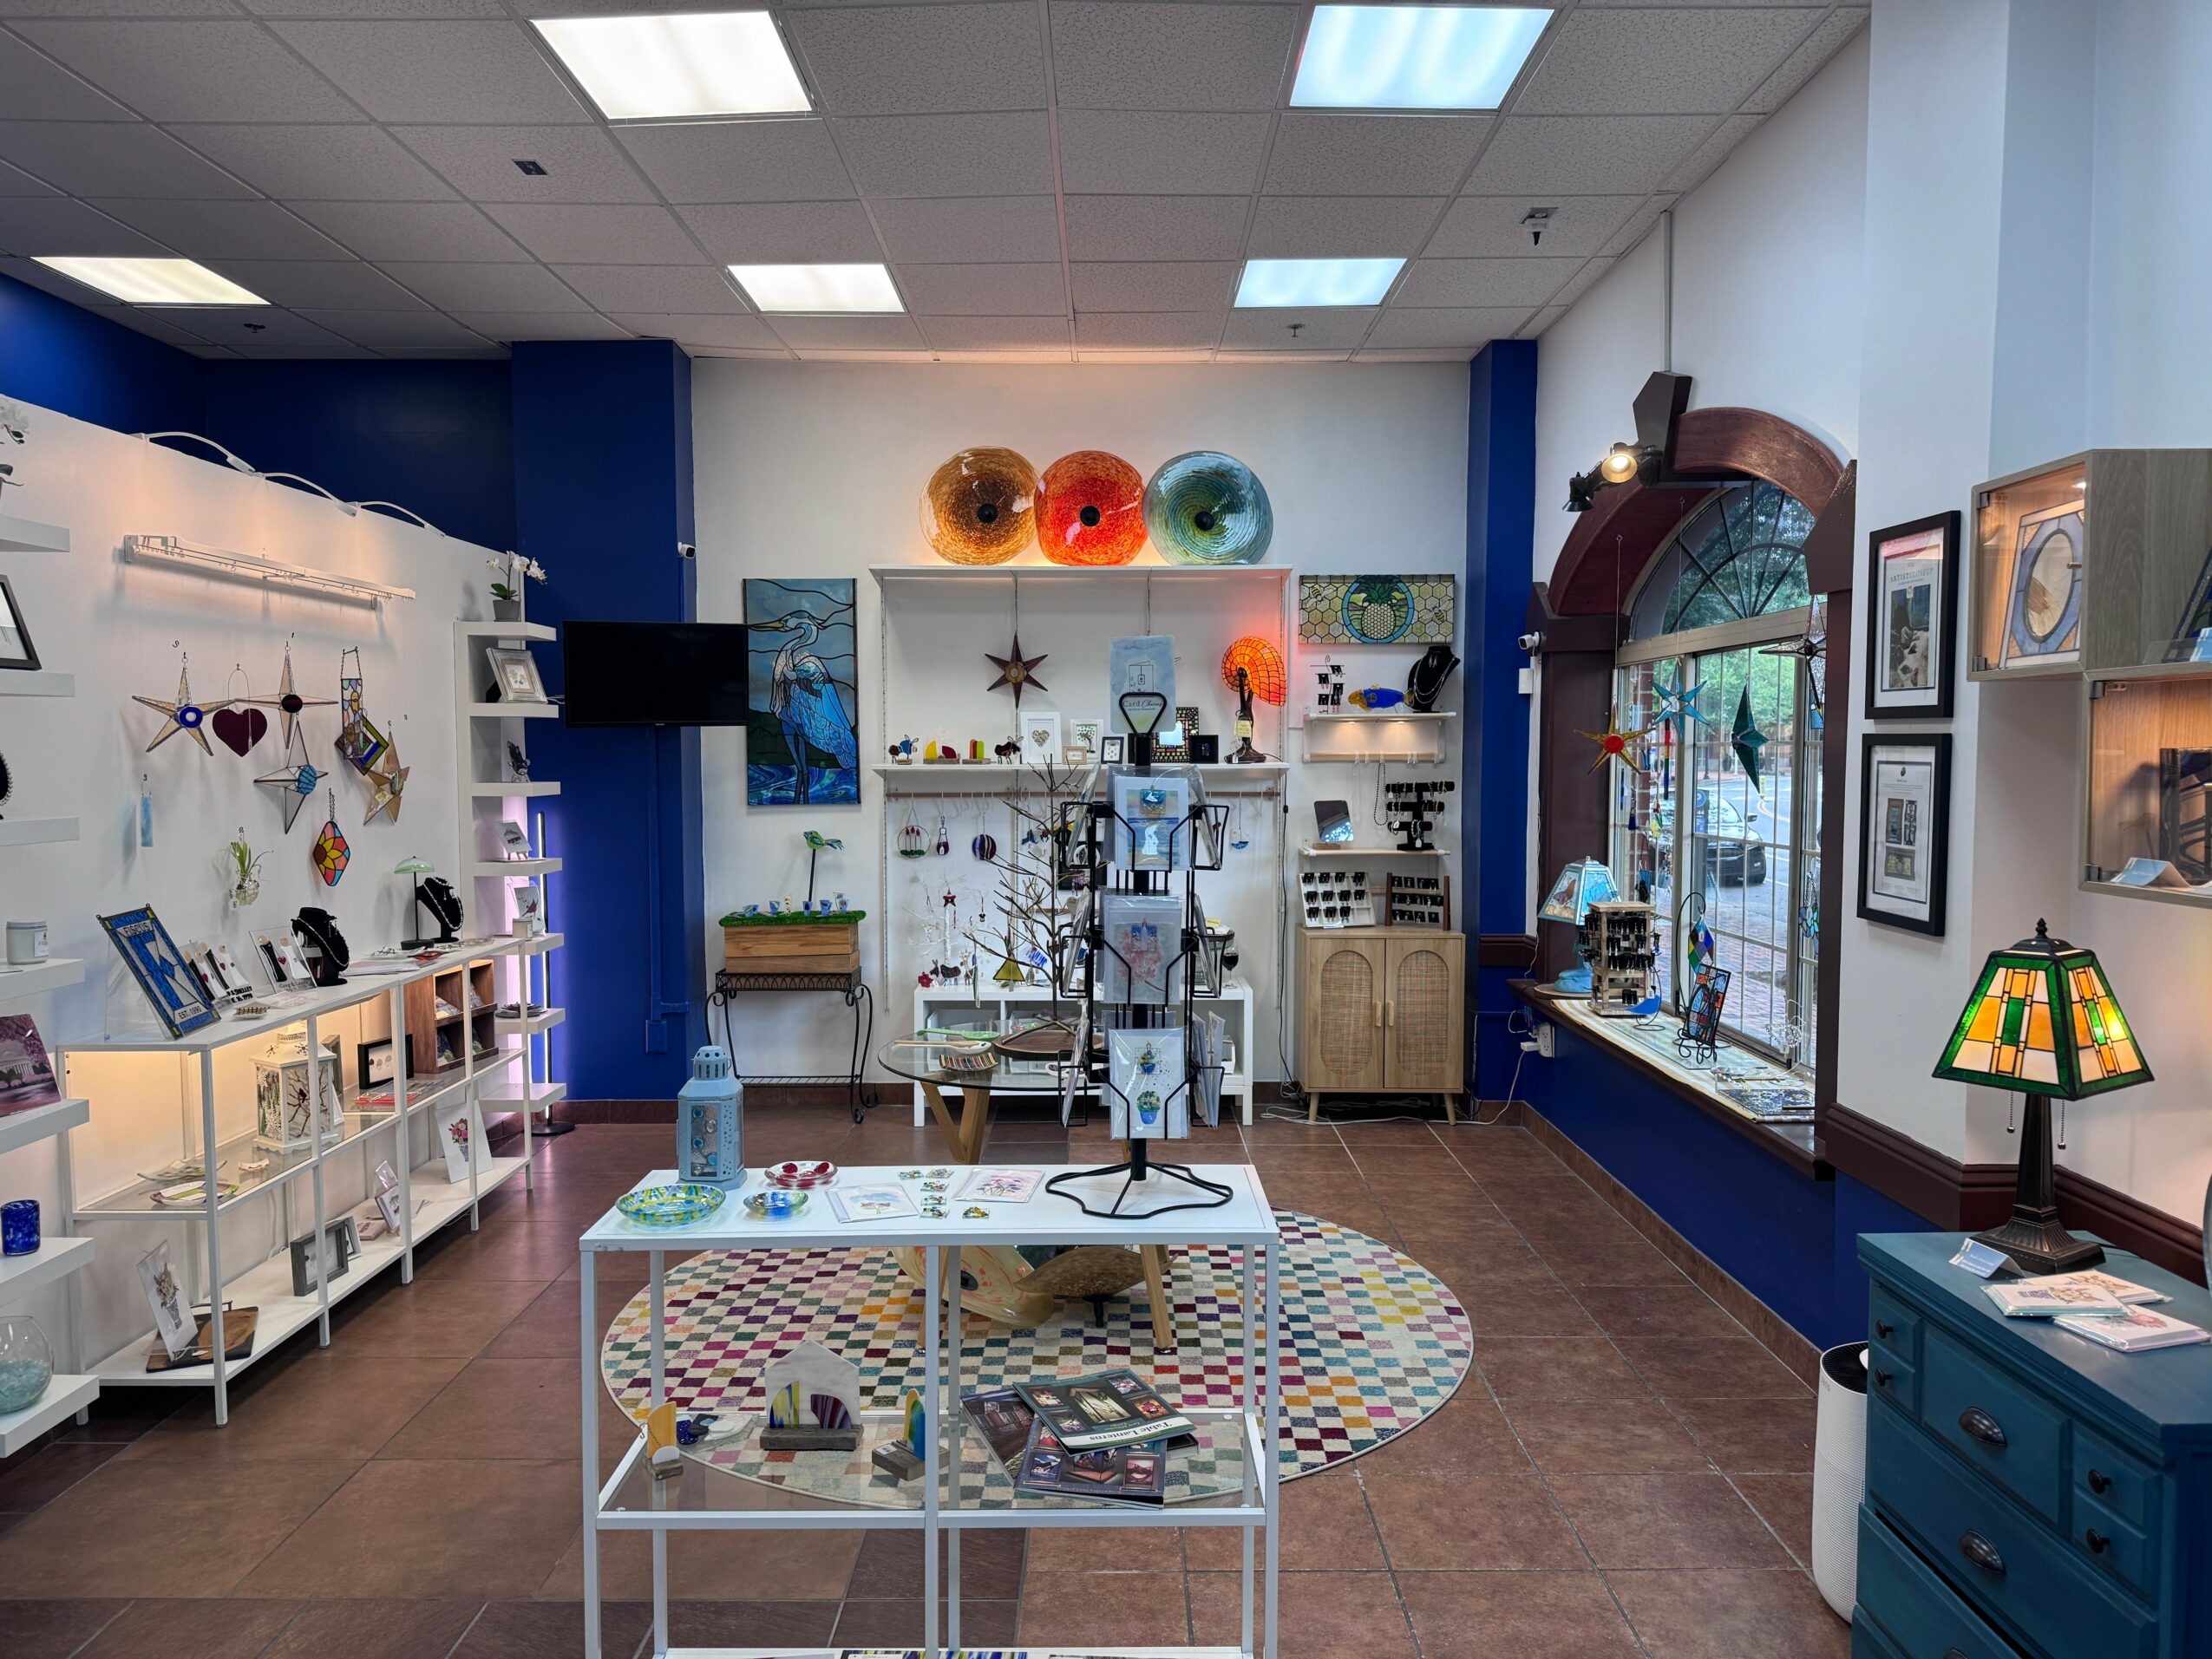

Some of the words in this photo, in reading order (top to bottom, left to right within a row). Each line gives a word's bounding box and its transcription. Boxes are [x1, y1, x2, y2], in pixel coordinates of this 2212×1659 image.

[123, 922, 151, 937] FISCUS
[234, 985, 252, 995] SHELLEY
[179, 1009, 190, 1019] EST.
[191, 1006, 202, 1016] 1990
[1141, 1421, 1172, 1433] Table
[1090, 1429, 1139, 1440] Lanterns
